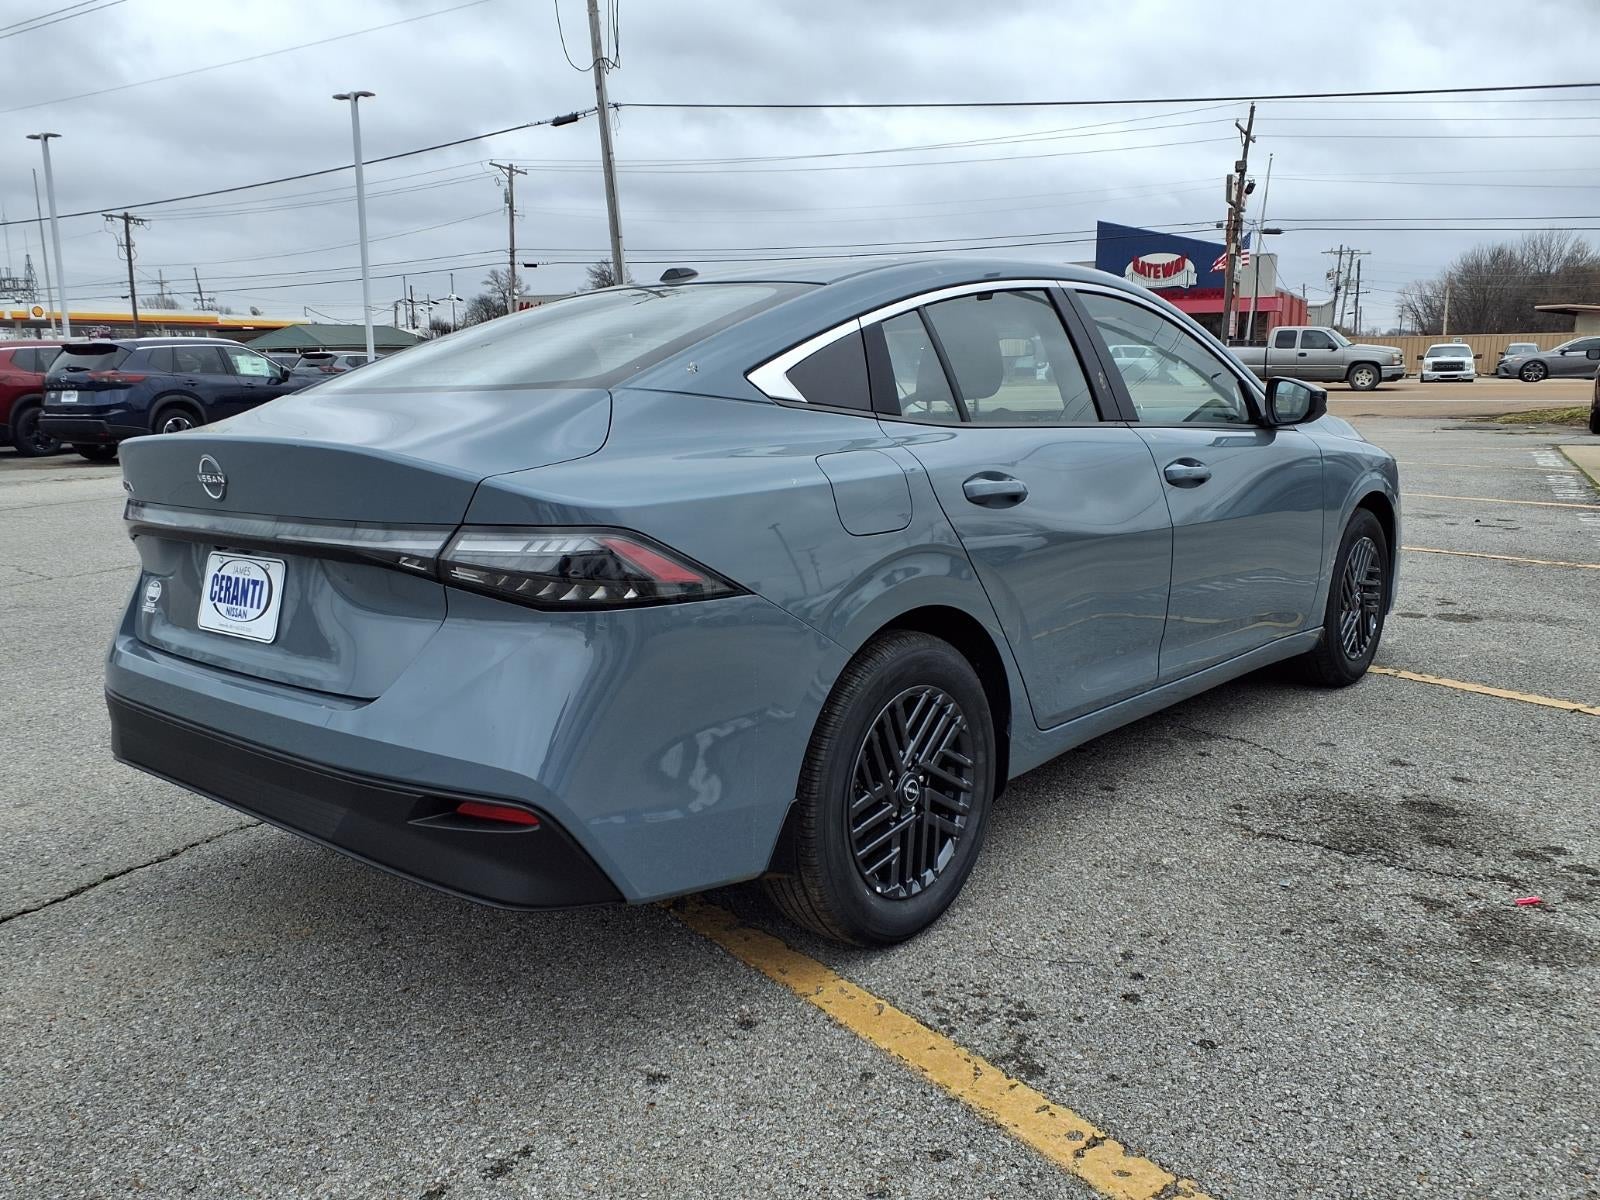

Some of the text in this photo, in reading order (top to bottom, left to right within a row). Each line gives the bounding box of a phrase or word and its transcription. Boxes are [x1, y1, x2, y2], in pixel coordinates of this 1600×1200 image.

[1132, 255, 1187, 279] GATEWAY
[233, 565, 251, 576] JAMES
[210, 573, 264, 609] CERANTI
[226, 606, 248, 619] NISSAN
